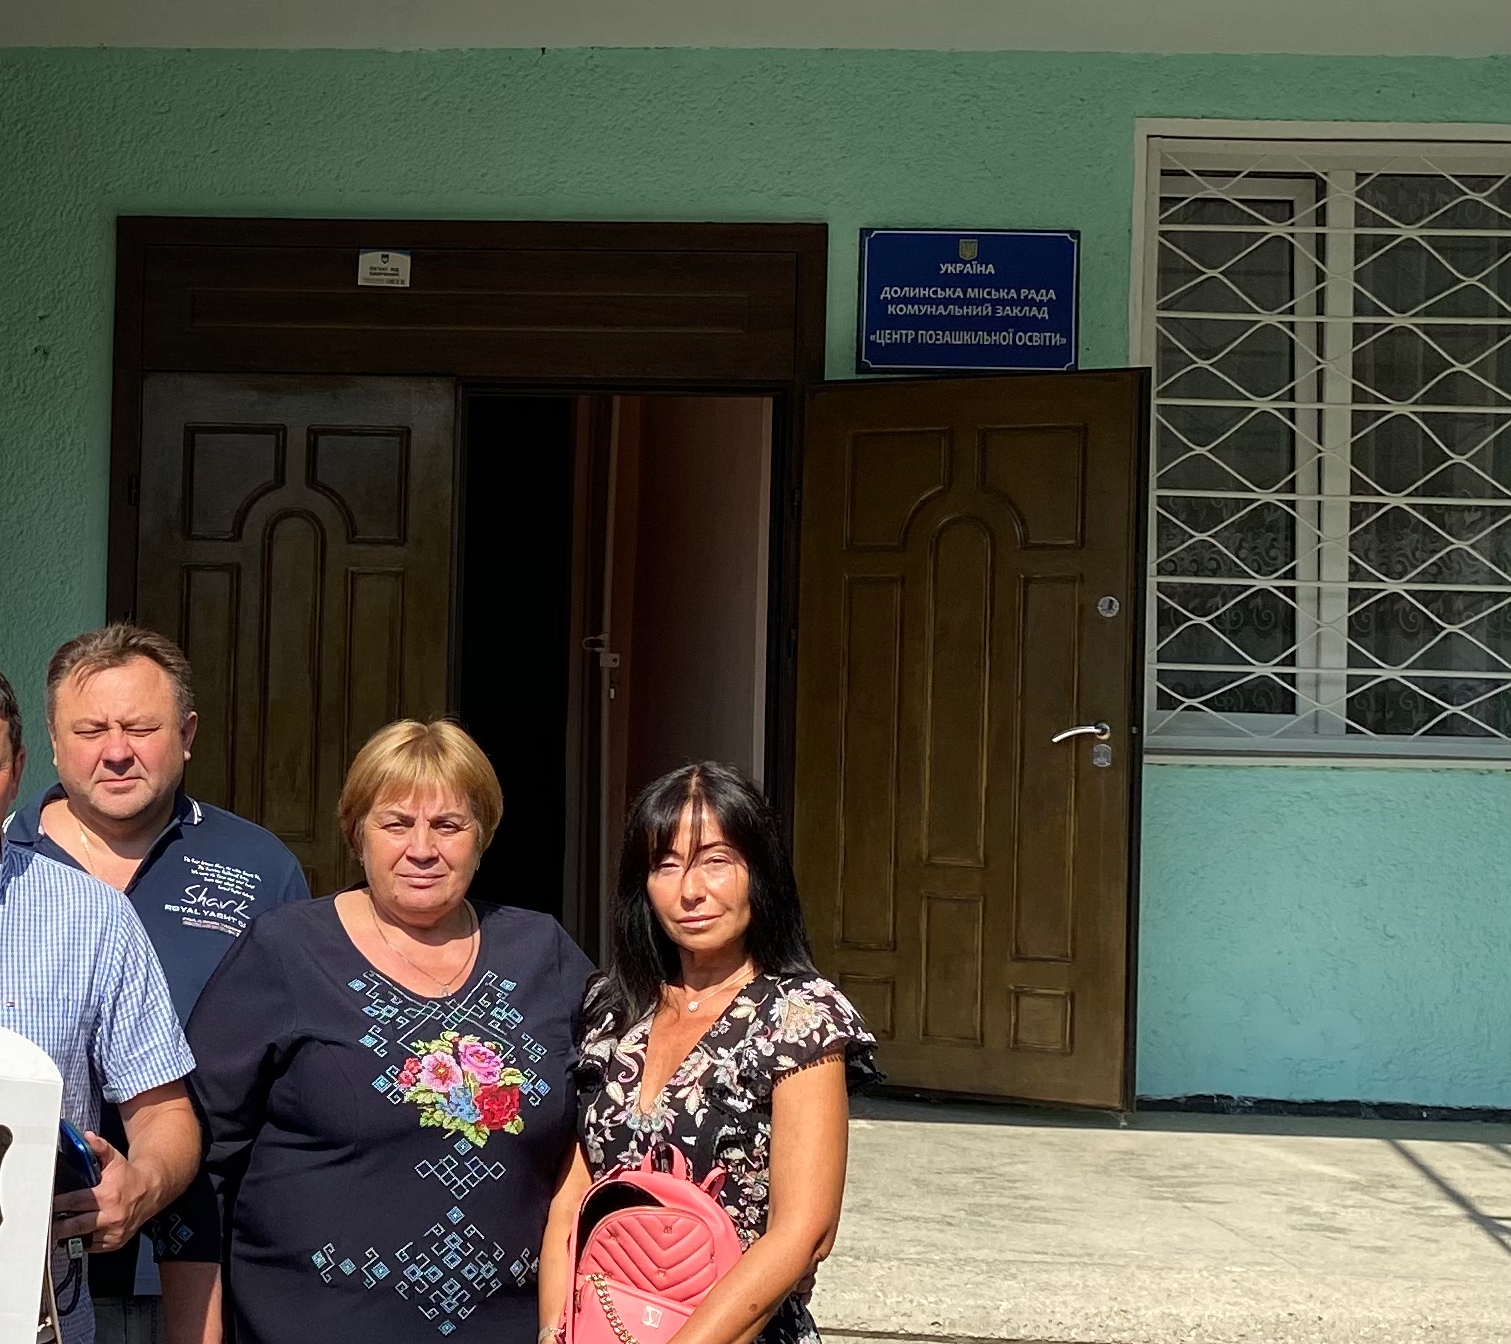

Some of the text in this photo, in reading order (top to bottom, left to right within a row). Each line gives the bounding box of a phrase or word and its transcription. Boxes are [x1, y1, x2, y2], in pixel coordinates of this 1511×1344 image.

[939, 261, 996, 275] УКРАЇНА
[880, 286, 1057, 303] ДОЛИНСЬКА МІСЬКА РАДА
[887, 303, 1049, 320] КОМУНАЛЬНИЙ ЗАКЛАД
[917, 328, 1015, 346] ПОЗАШКІЛЬНОЇ
[164, 903, 201, 916] ROYAL
[180, 884, 251, 920] Shark
